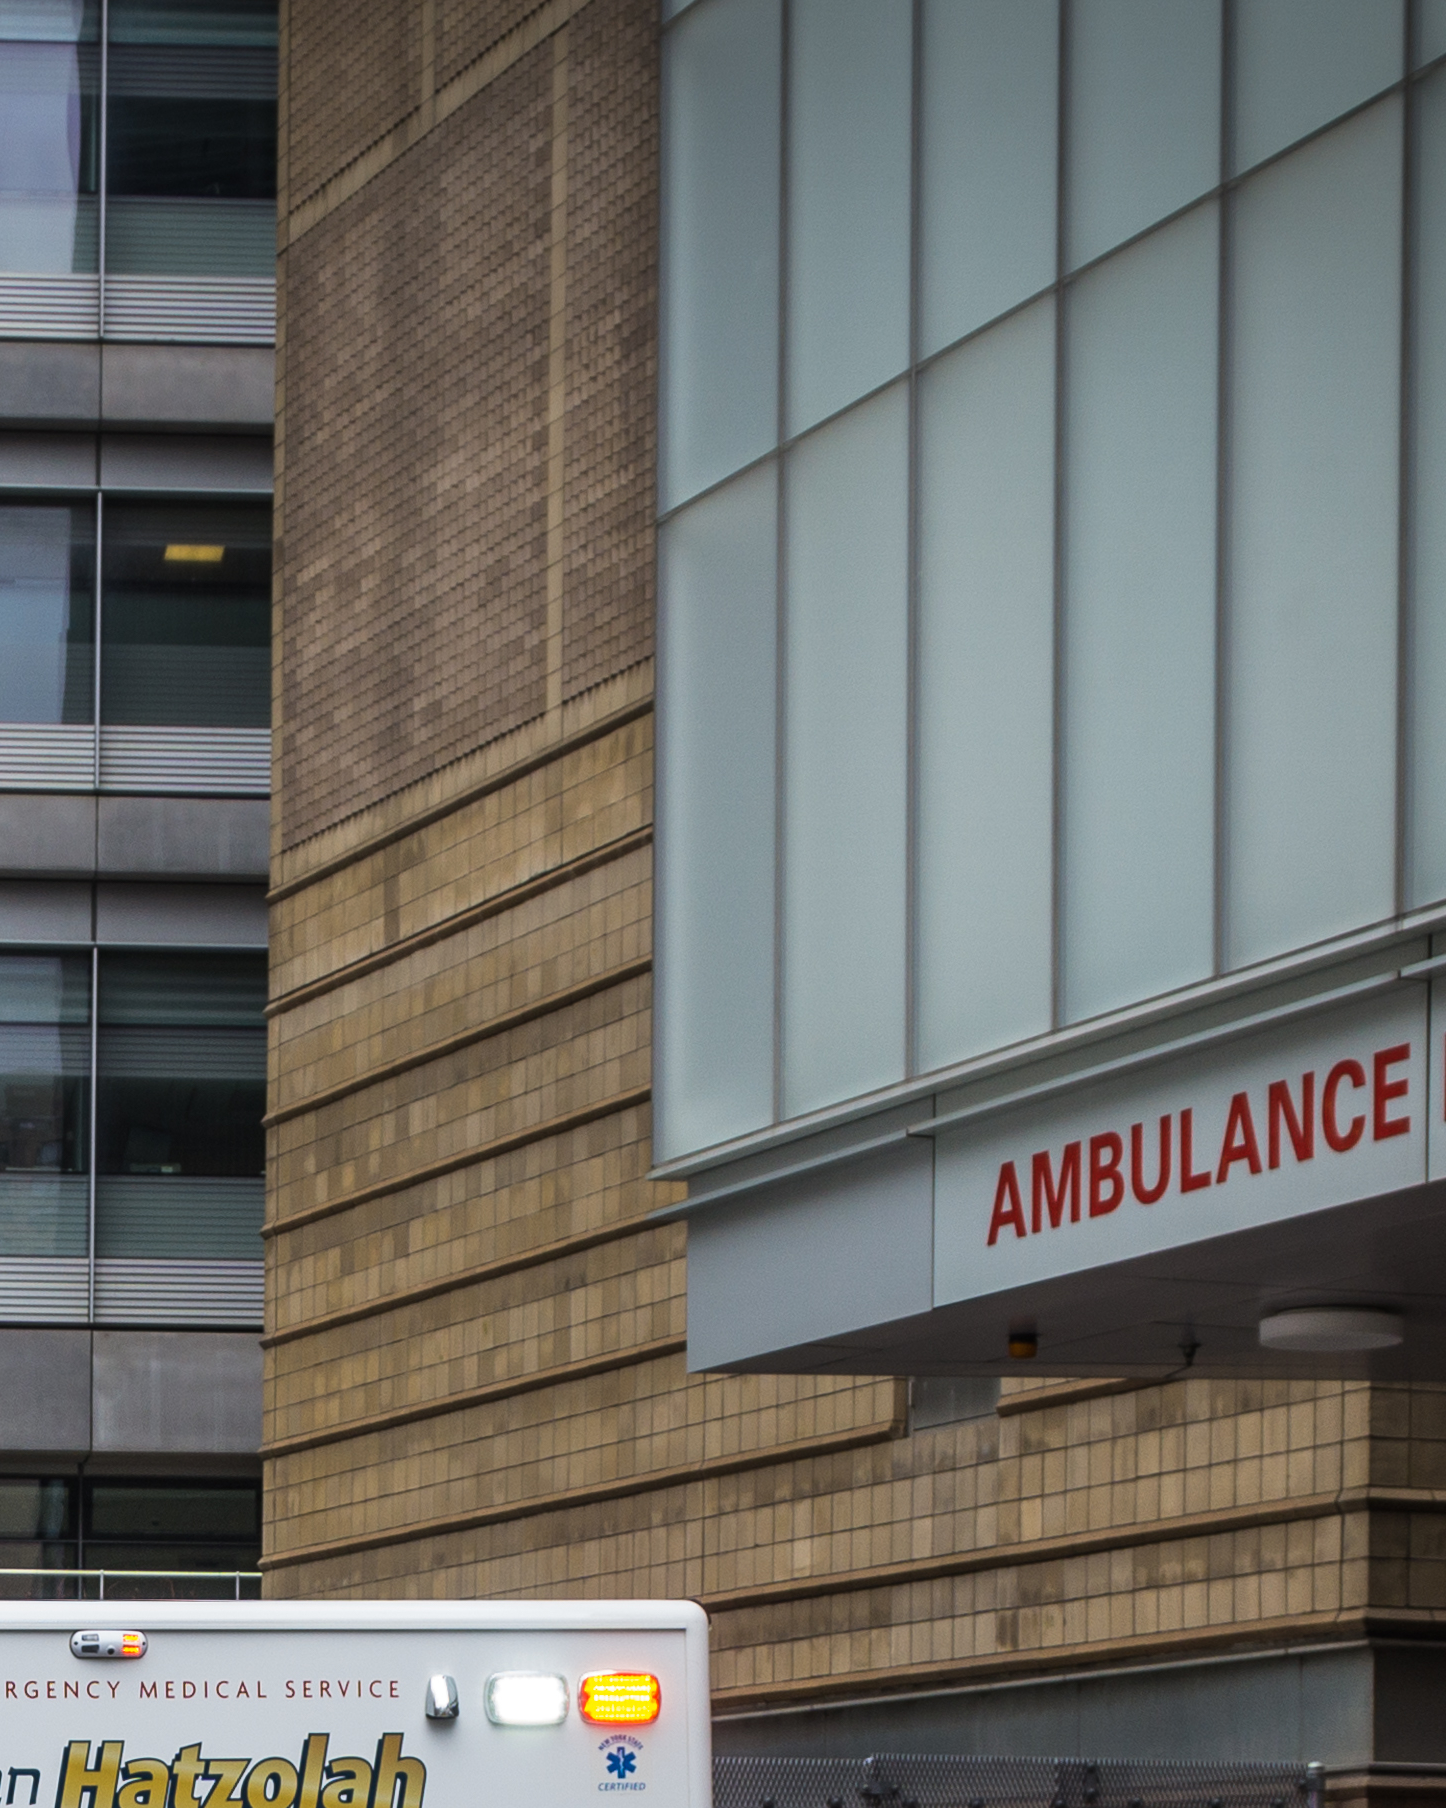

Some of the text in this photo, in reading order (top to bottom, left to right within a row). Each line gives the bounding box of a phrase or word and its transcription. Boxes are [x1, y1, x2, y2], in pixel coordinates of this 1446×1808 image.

[987, 1043, 1412, 1246] AMBULANCE
[140, 1680, 267, 1699] MEDICAL
[285, 1680, 401, 1699] SERVICE
[598, 1782, 646, 1791] CERTIFIED
